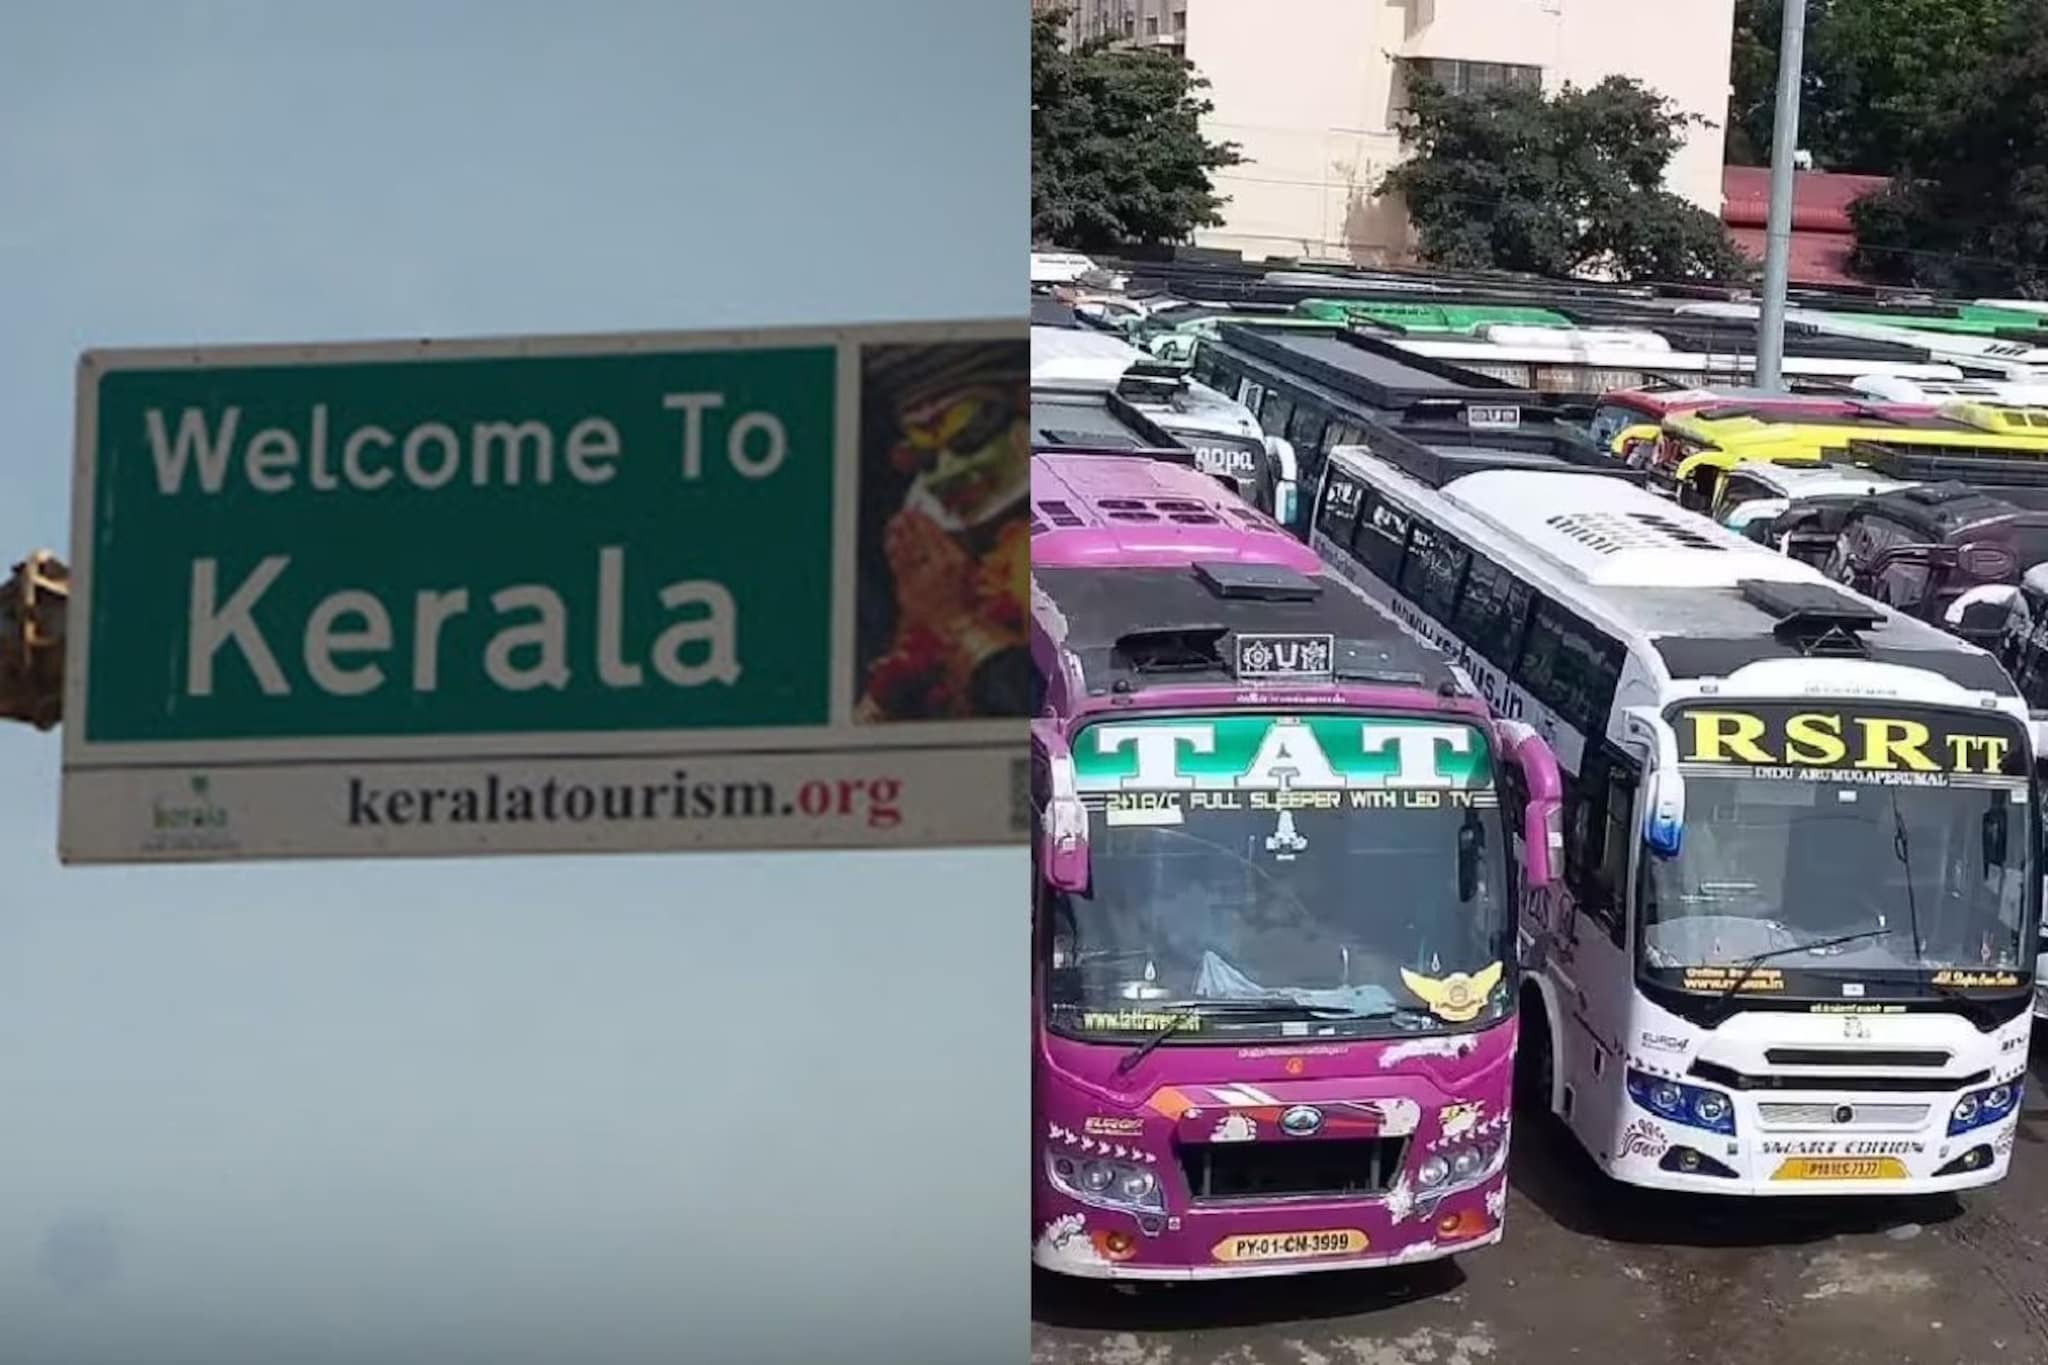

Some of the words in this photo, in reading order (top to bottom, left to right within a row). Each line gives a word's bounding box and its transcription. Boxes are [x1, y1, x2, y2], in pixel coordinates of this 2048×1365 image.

[146, 402, 621, 494] Welcome
[663, 392, 787, 480] To
[187, 546, 742, 698] Kerala
[1098, 720, 1470, 789] TAT
[1683, 711, 1941, 772] RSR
[348, 771, 903, 829] keralatourism.org
[1190, 792, 1242, 809] FULL
[1250, 792, 1342, 811] SLEEPER
[1350, 791, 1397, 809] WITH
[1403, 791, 1441, 809] LED
[1449, 791, 1473, 808] TV
